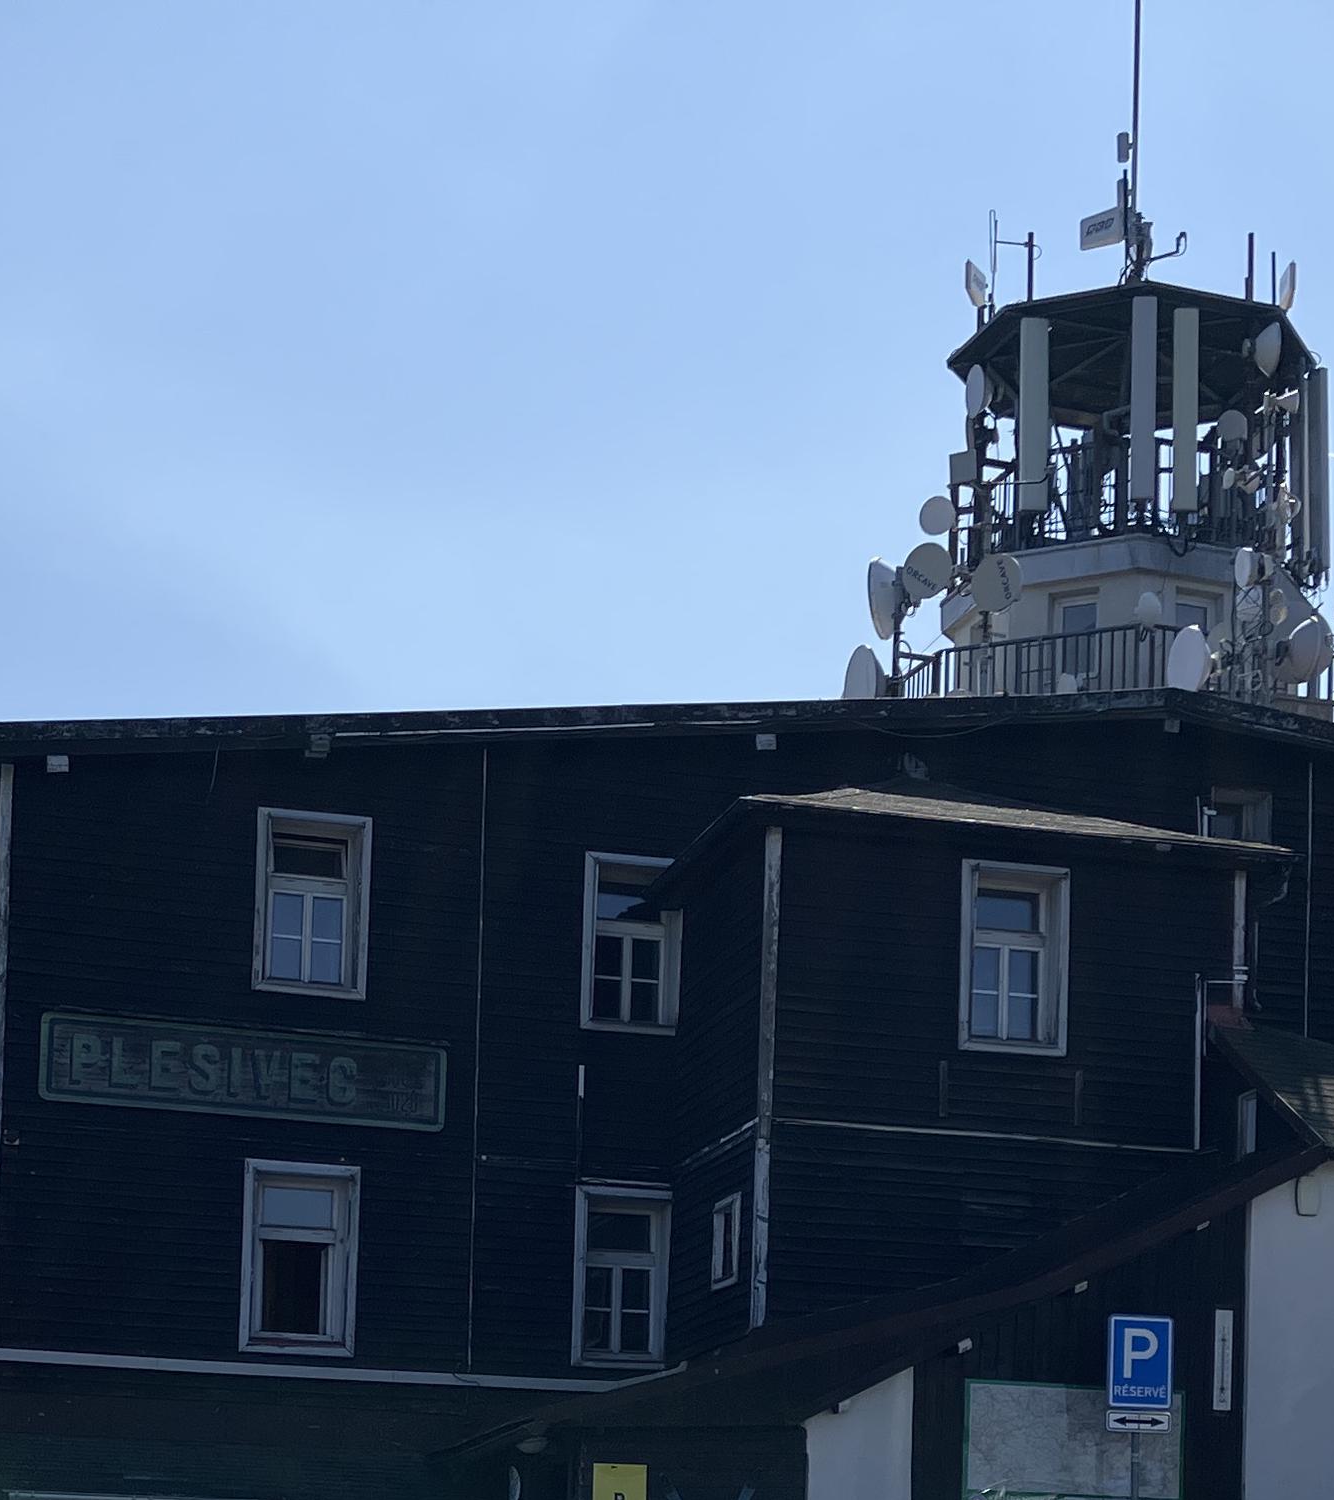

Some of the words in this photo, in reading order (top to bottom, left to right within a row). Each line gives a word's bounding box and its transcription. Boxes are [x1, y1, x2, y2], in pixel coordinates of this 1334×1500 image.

[906, 565, 937, 591] ORCAVE
[996, 559, 1012, 600] ORCAVE
[1122, 1327, 1158, 1379] P
[1113, 1383, 1167, 1399] RÉSERVÉ
